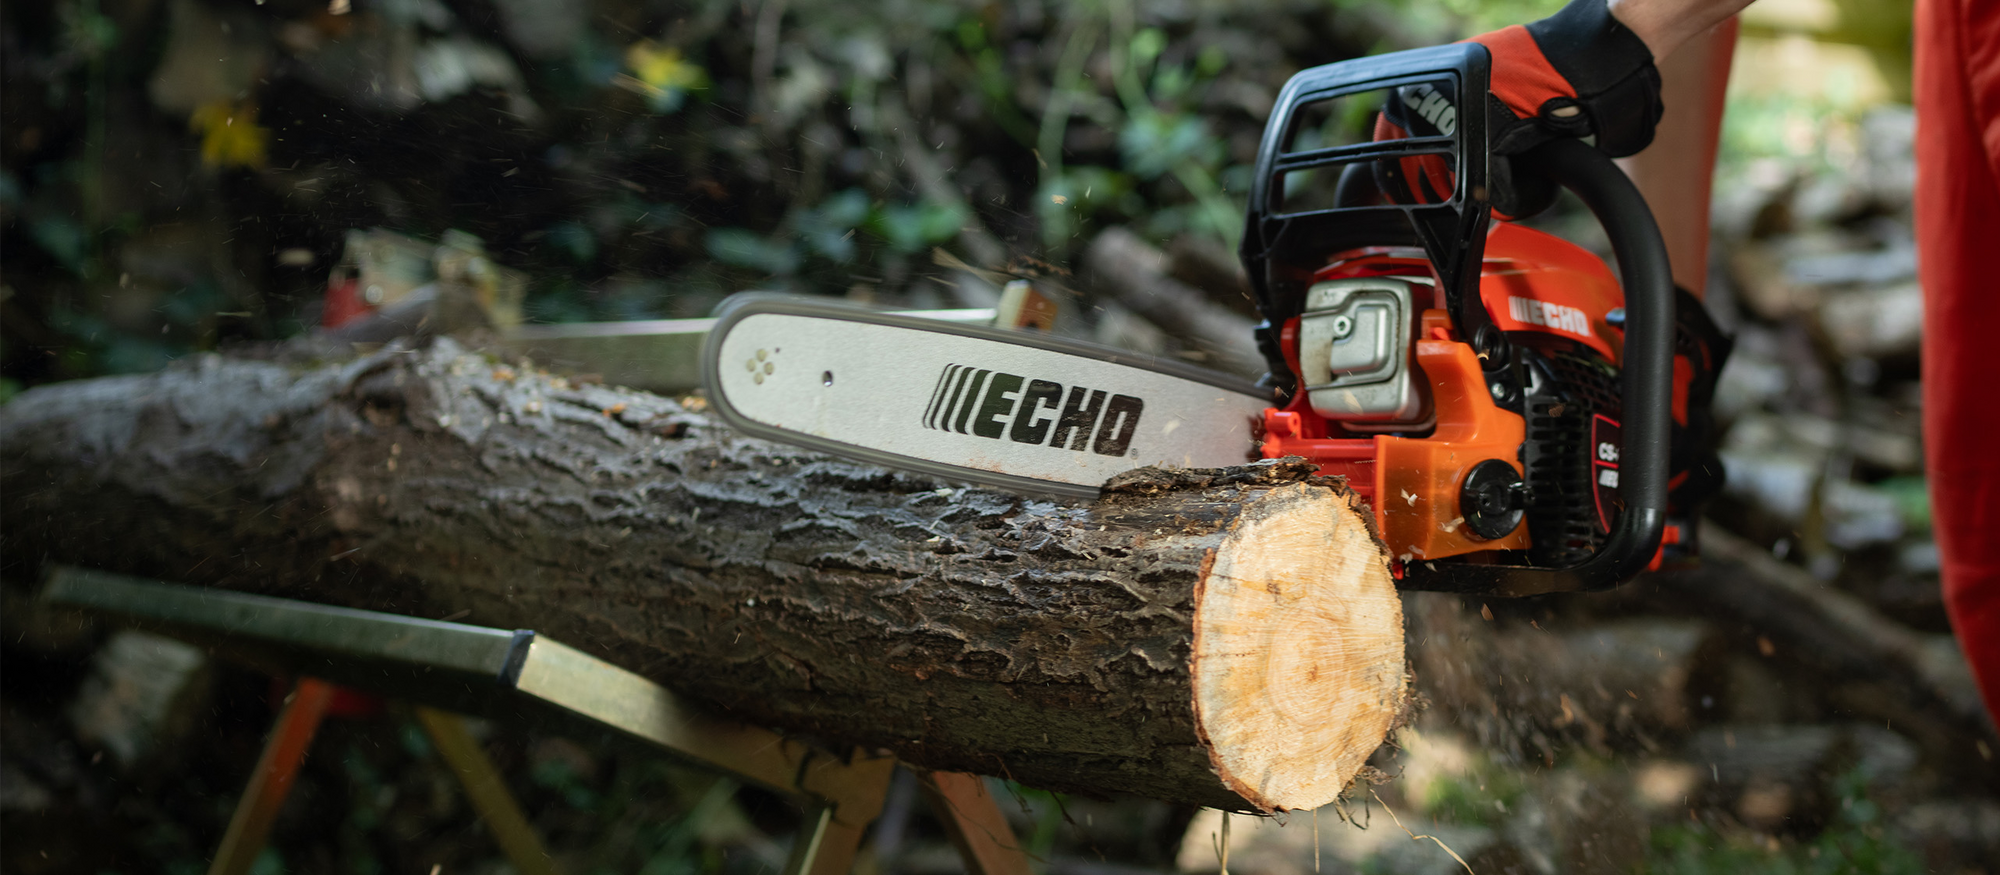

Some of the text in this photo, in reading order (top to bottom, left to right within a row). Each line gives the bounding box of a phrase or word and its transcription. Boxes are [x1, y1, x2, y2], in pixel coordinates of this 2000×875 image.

[1401, 83, 1456, 136] CHO
[1528, 299, 1592, 337] ECHO
[973, 372, 1144, 457] ECHO
[1598, 442, 1619, 462] CS-
